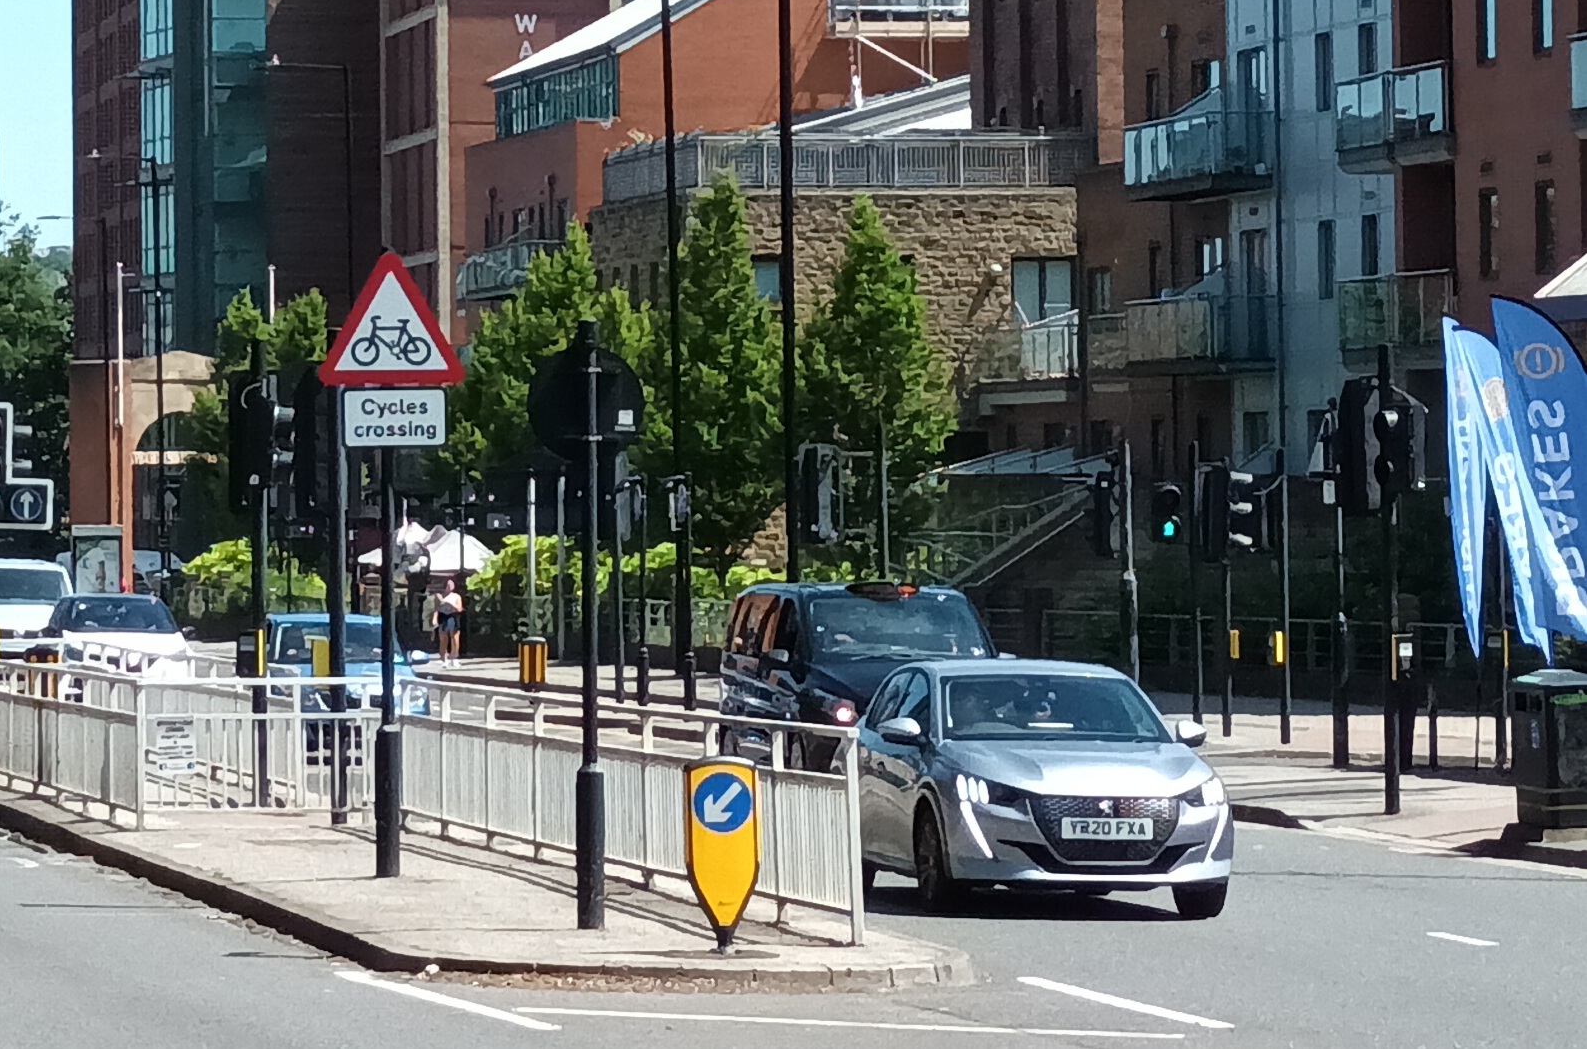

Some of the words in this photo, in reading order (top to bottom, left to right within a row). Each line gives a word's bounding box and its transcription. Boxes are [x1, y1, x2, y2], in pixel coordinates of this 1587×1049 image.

[360, 397, 429, 419] Cycles
[354, 420, 437, 441] crossing
[1115, 821, 1146, 836] FXA
